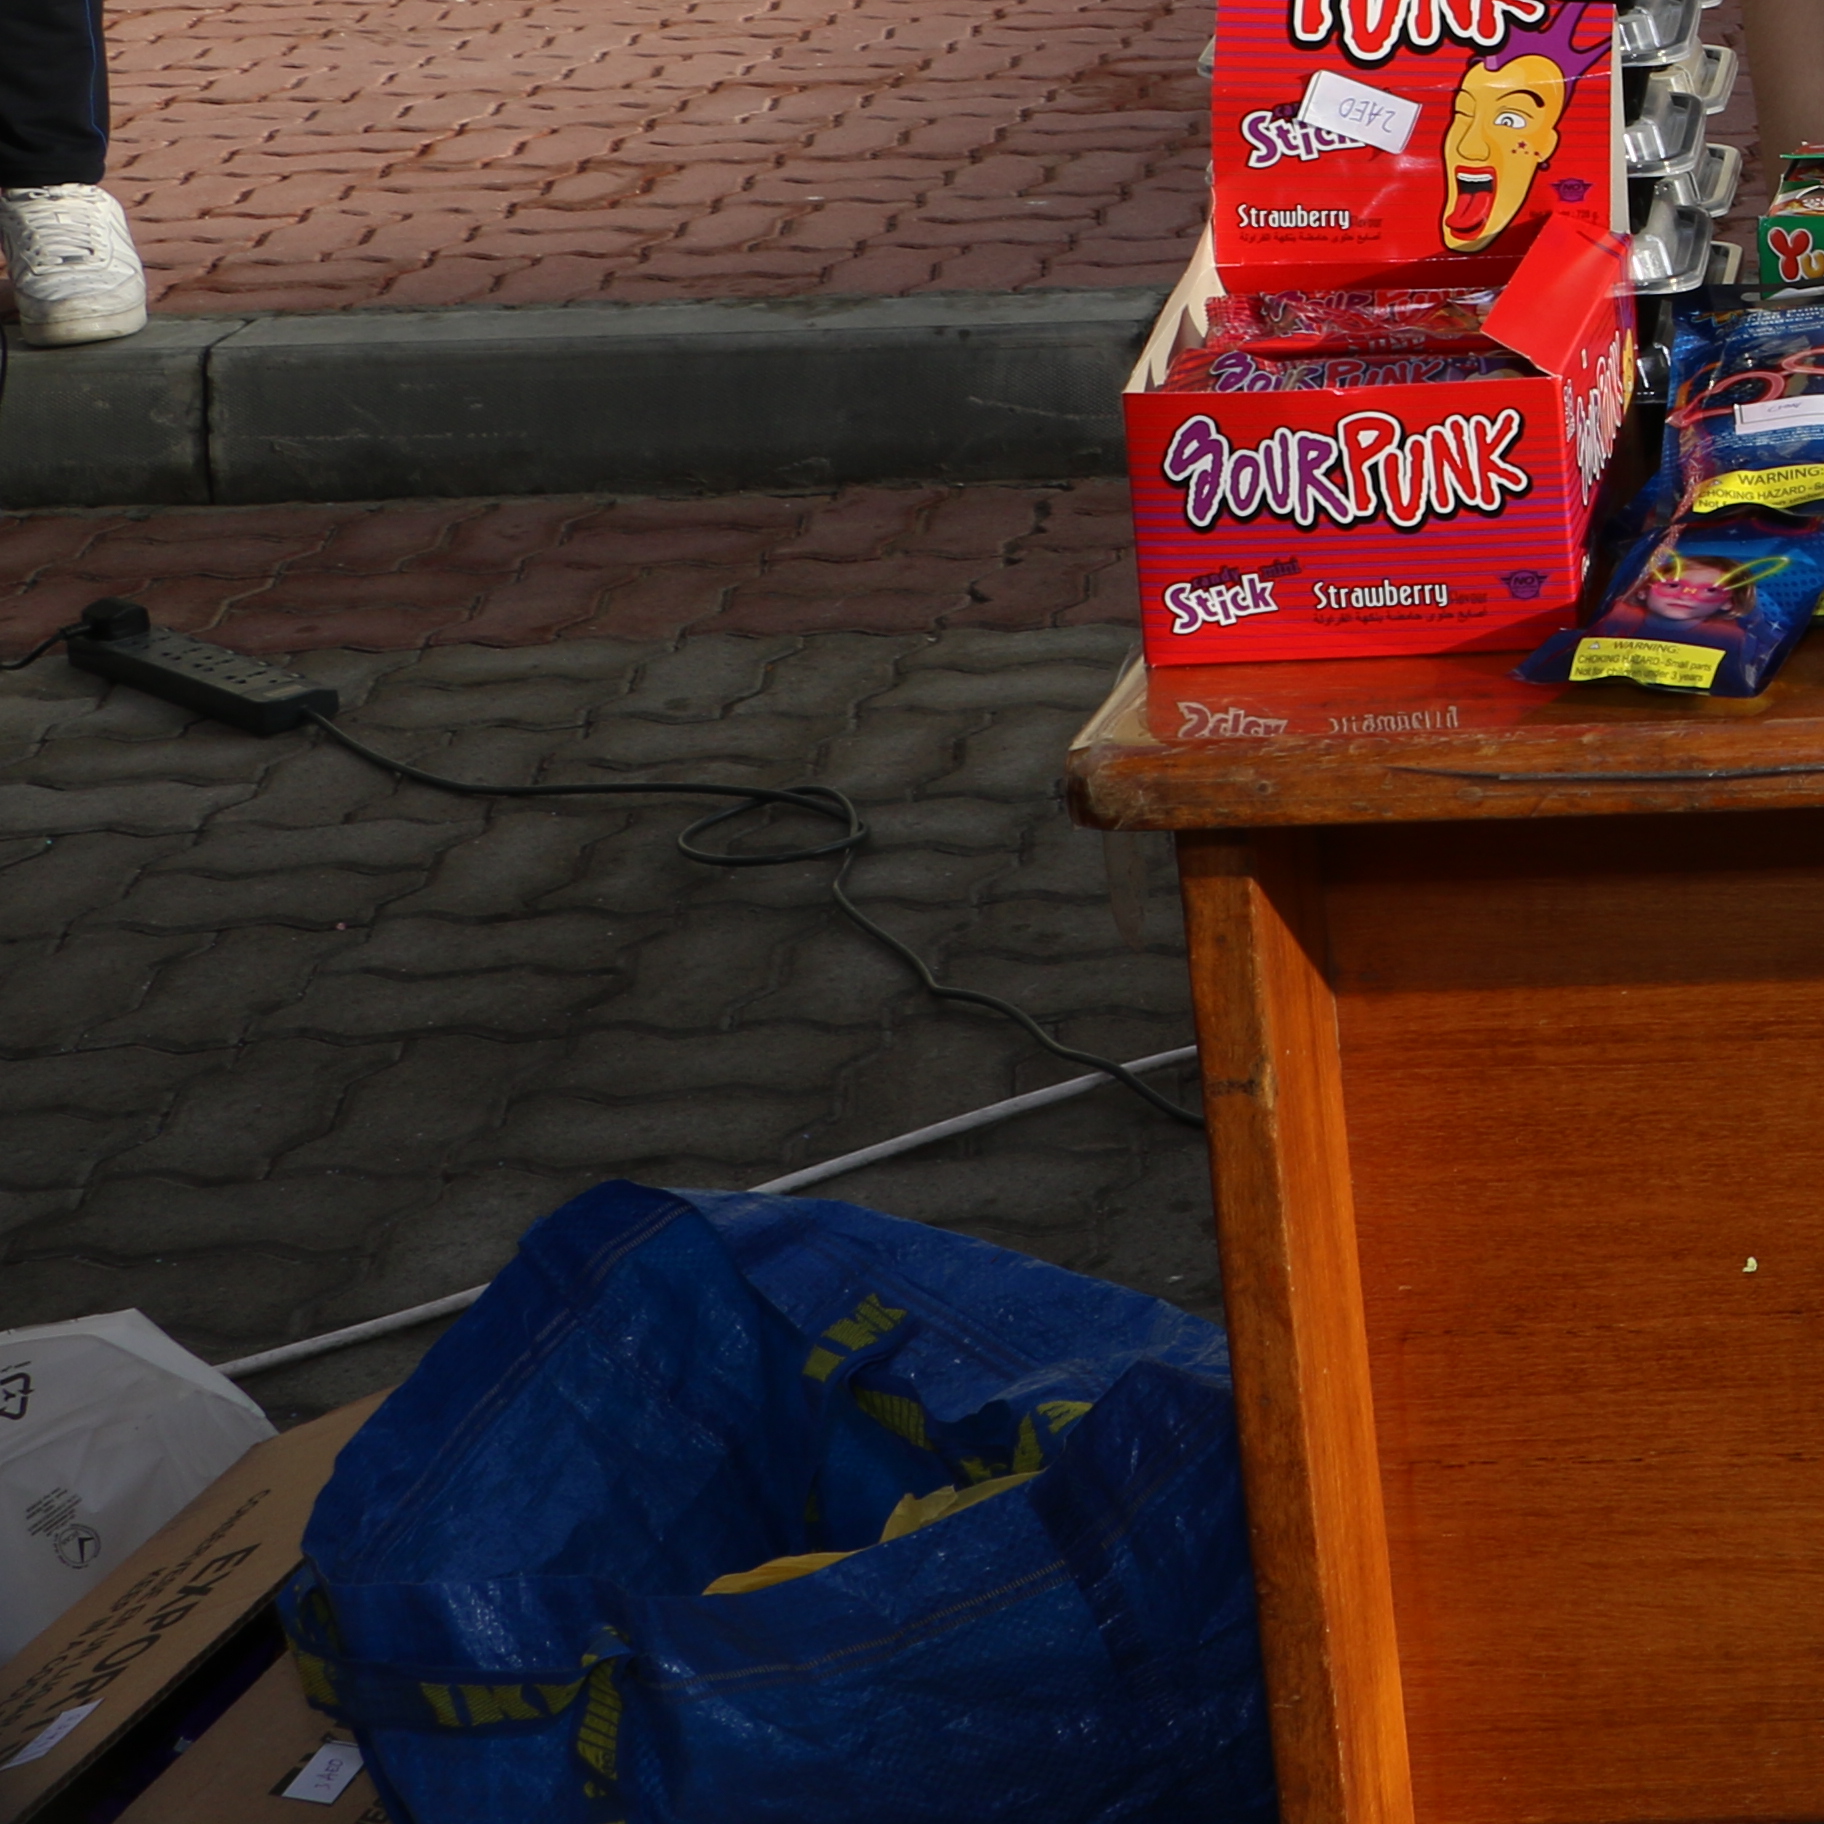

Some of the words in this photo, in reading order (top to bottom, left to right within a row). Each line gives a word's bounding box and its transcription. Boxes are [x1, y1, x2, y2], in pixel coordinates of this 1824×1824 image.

[1236, 202, 1350, 230] Strawberry
[1738, 467, 1824, 487] WARNING:
[1698, 488, 1755, 501] CHOKING
[1757, 484, 1807, 501] HAZARD
[1312, 579, 1449, 610] Strawberry
[1163, 573, 1279, 636] Stick
[1613, 641, 1680, 654] WARNING:
[1577, 654, 1620, 664] CHOKING
[1666, 659, 1689, 669] Small
[1690, 662, 1713, 672] parts
[1679, 672, 1704, 683] years
